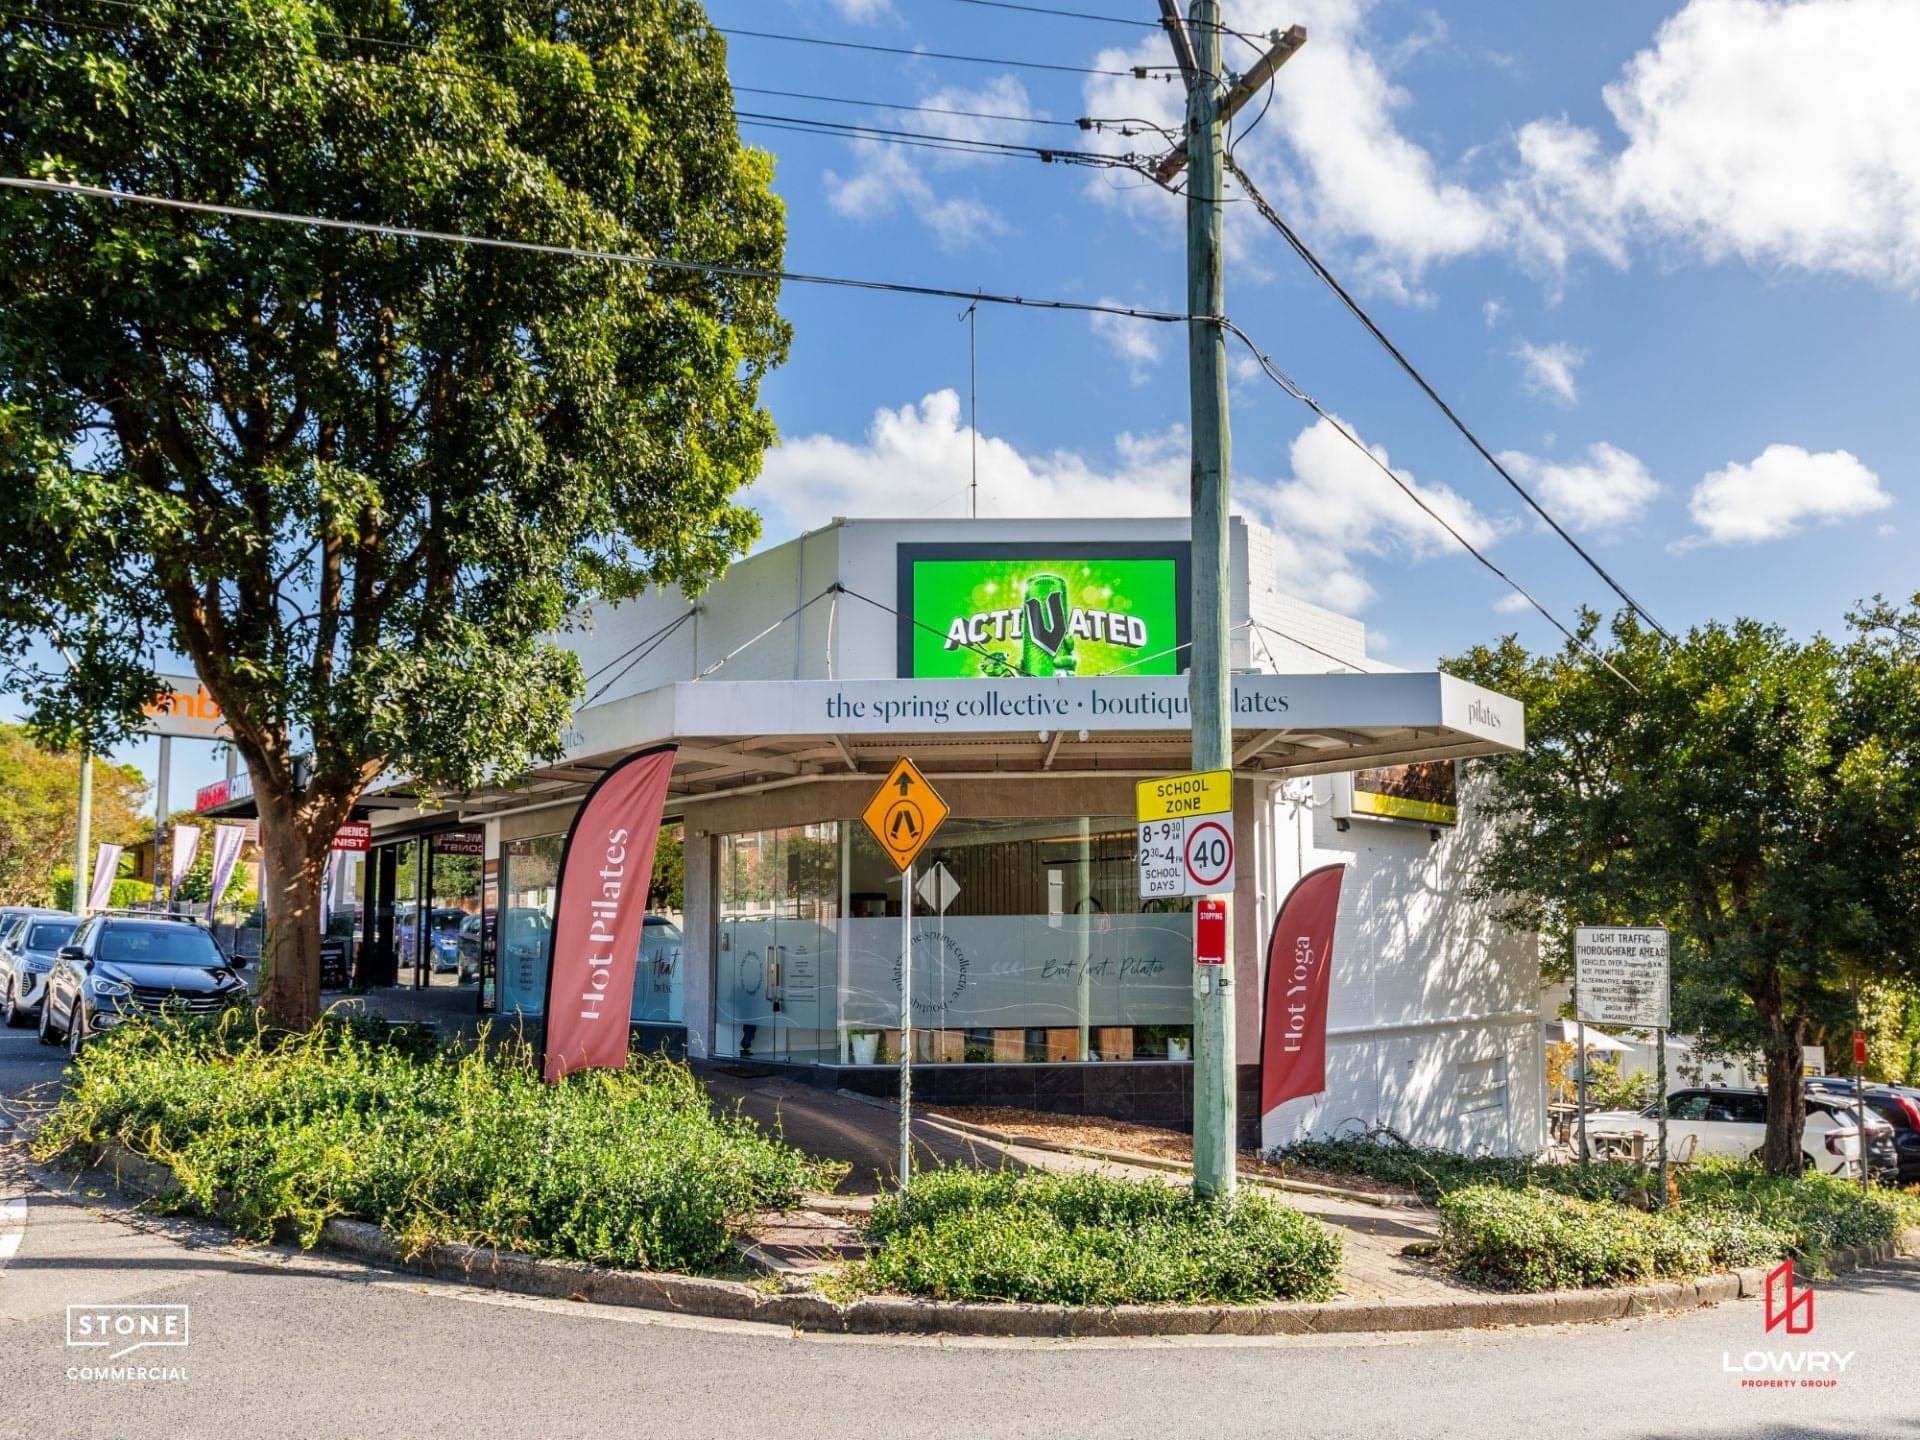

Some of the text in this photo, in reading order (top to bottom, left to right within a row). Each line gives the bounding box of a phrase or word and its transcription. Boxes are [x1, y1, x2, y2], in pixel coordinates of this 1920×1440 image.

[944, 592, 1147, 657] ACTIVATED
[826, 688, 1289, 723] the spring collective boutiqu lates
[1468, 699, 1501, 728] pilates
[1157, 780, 1209, 797] SCHOOL
[1166, 797, 1201, 813] ZONE
[333, 838, 366, 848] NIST
[1193, 839, 1225, 868] 40
[1145, 868, 1180, 879] SCHOOL
[1150, 881, 1174, 892] DAYS
[580, 828, 628, 1020] Hot Pilates
[1200, 912, 1223, 920] STOPPING
[1592, 934, 1651, 944] LIGHT TRAFFIC
[1578, 946, 1666, 957] THOROUGHFARE AHEAD
[1284, 936, 1314, 1052] Hot Yoga
